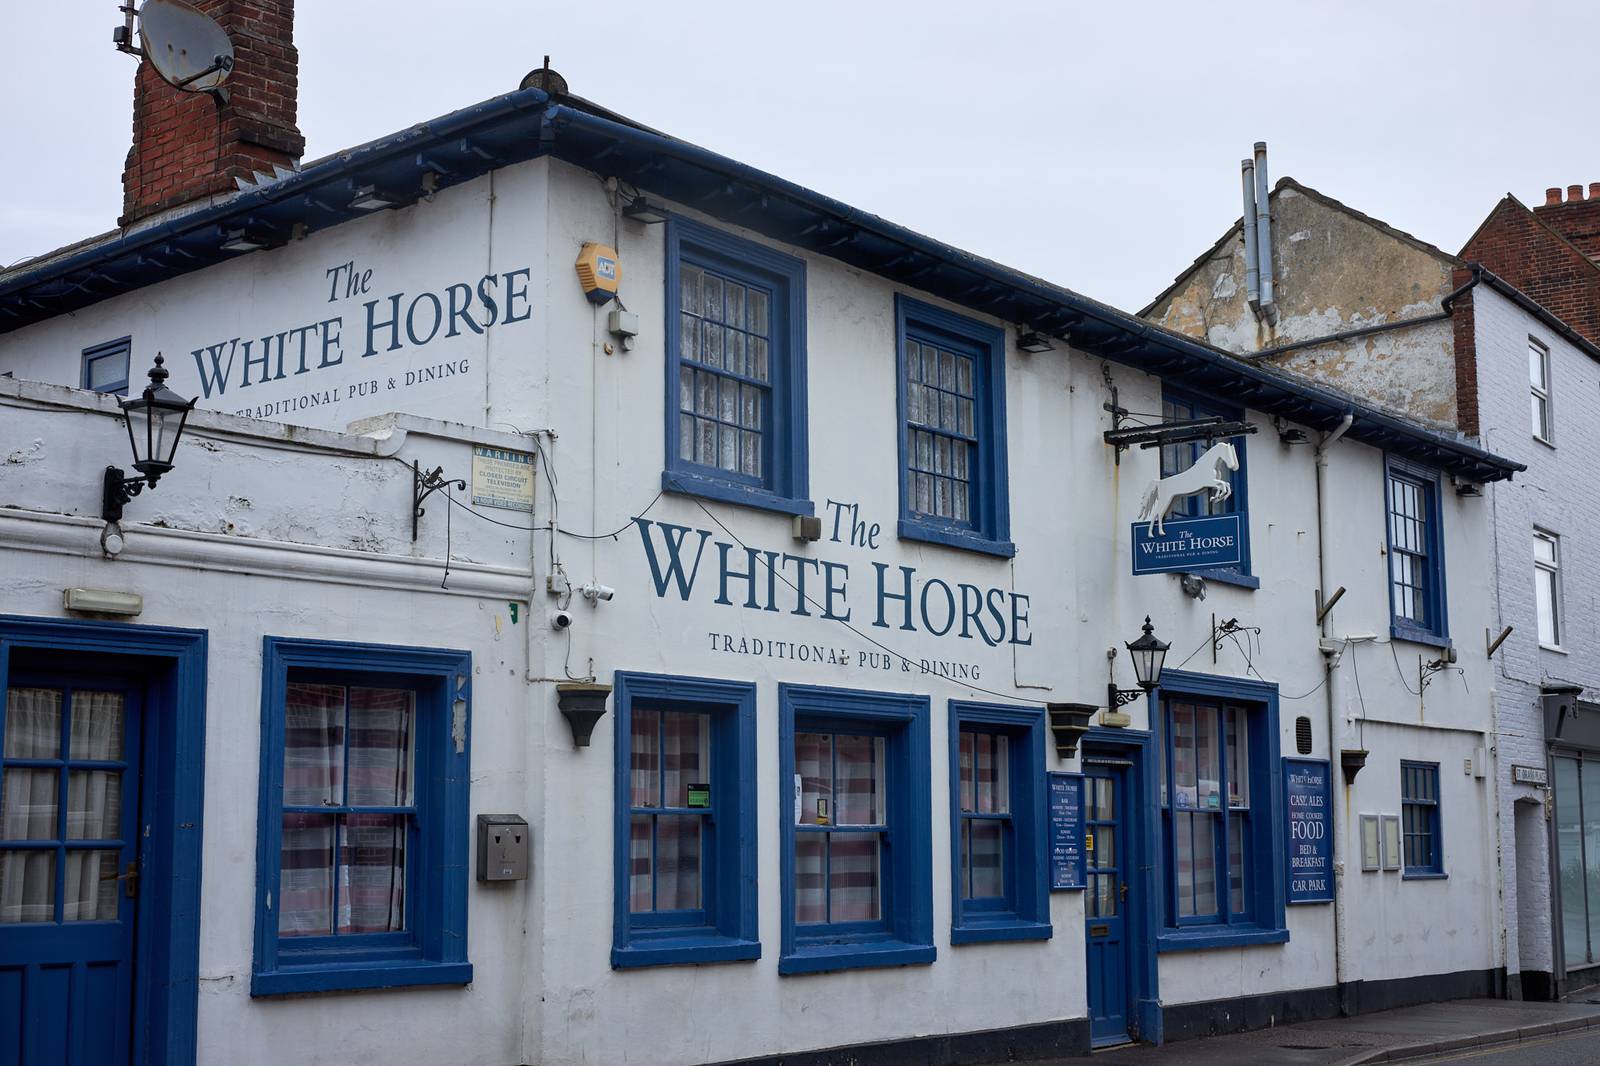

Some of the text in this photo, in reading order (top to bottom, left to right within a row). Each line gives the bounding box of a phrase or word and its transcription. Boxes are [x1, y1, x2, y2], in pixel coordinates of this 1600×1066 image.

[598, 261, 615, 278] ADT
[326, 260, 373, 303] The
[190, 267, 533, 399] WHITE HORSE
[236, 359, 470, 418] TRADITIONAL PUB & DINING
[475, 448, 535, 464] WARNING
[479, 471, 528, 484] CLOSED CIRCUIT
[487, 478, 521, 488] TELEVISION
[826, 499, 880, 550] The
[1179, 530, 1193, 539] The
[1141, 536, 1234, 554] WHITE HORSE
[630, 516, 1032, 647] WHITE HORSE
[709, 632, 980, 680] TRADITIONAL PUB & DINING
[1309, 796, 1324, 807] ALES
[1292, 821, 1324, 840] FOOD
[1299, 845, 1318, 855] BED &
[1292, 857, 1326, 868] BREAKFAST
[1292, 879, 1326, 892] CAR PARK
